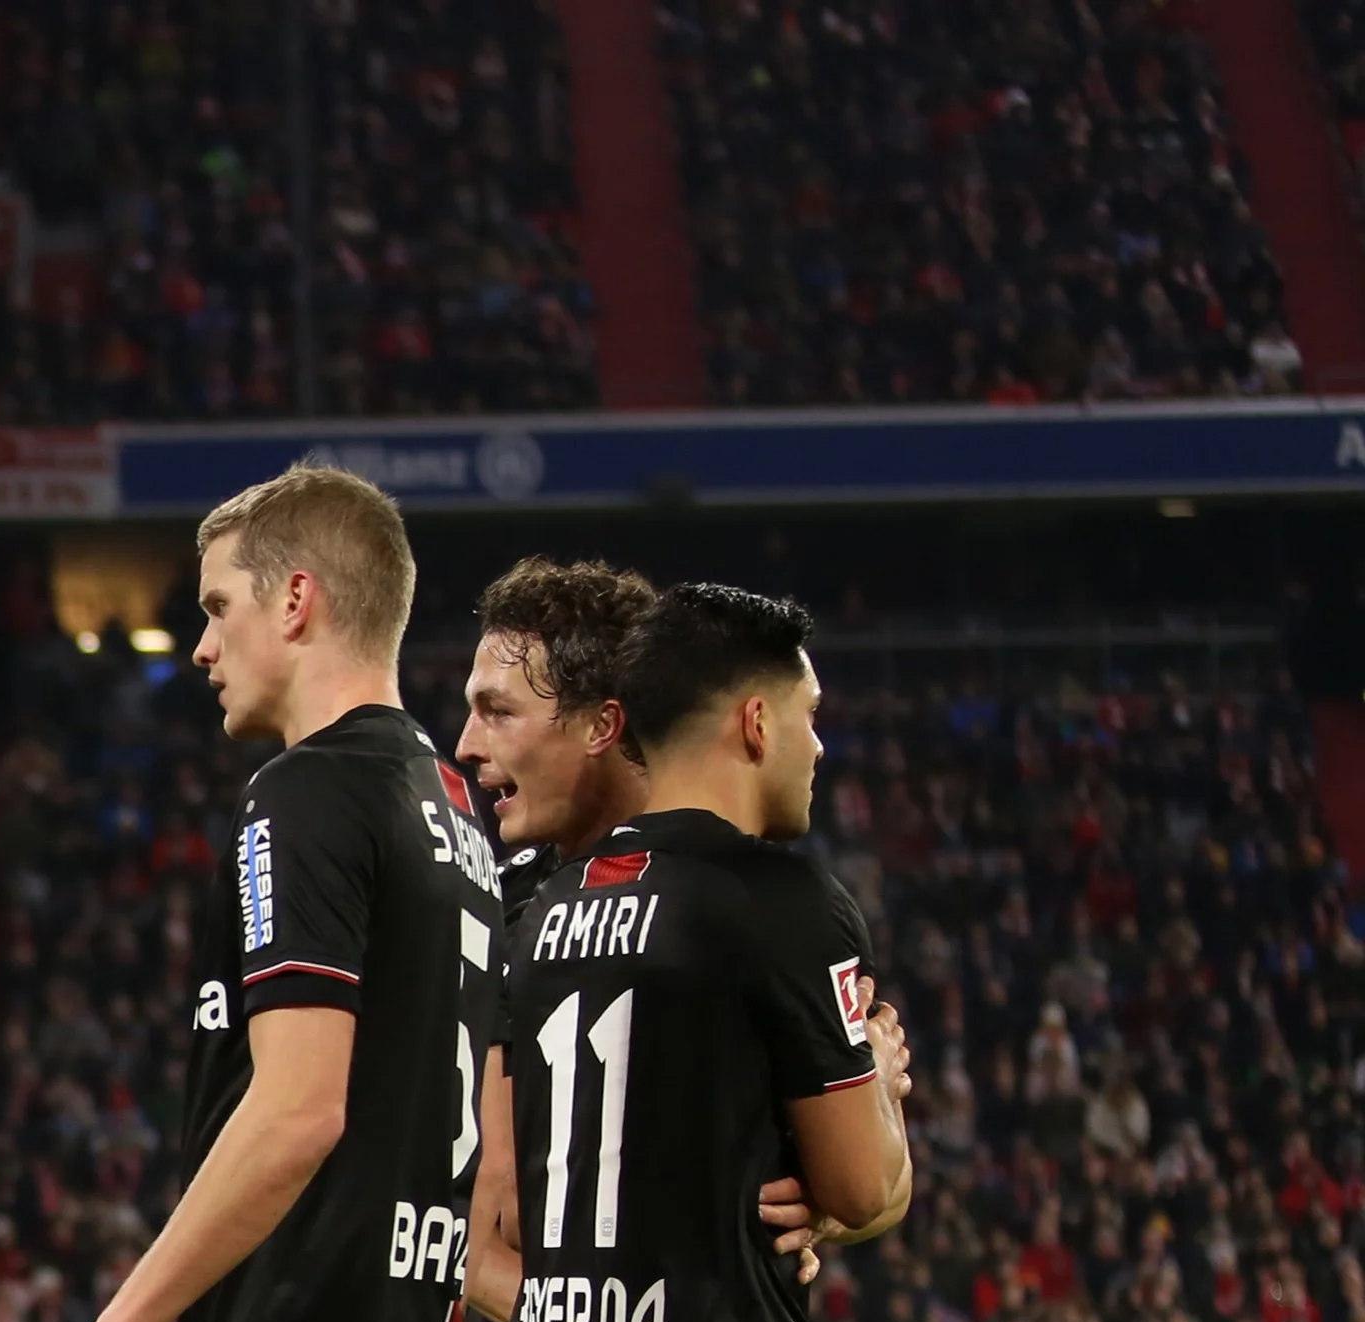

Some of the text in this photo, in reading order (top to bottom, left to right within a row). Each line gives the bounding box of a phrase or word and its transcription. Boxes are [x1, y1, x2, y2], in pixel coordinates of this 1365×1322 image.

[237, 826, 257, 953] TRAINING
[253, 817, 273, 945] KIESER
[533, 894, 659, 961] AMIRI
[536, 987, 634, 1248] 11
